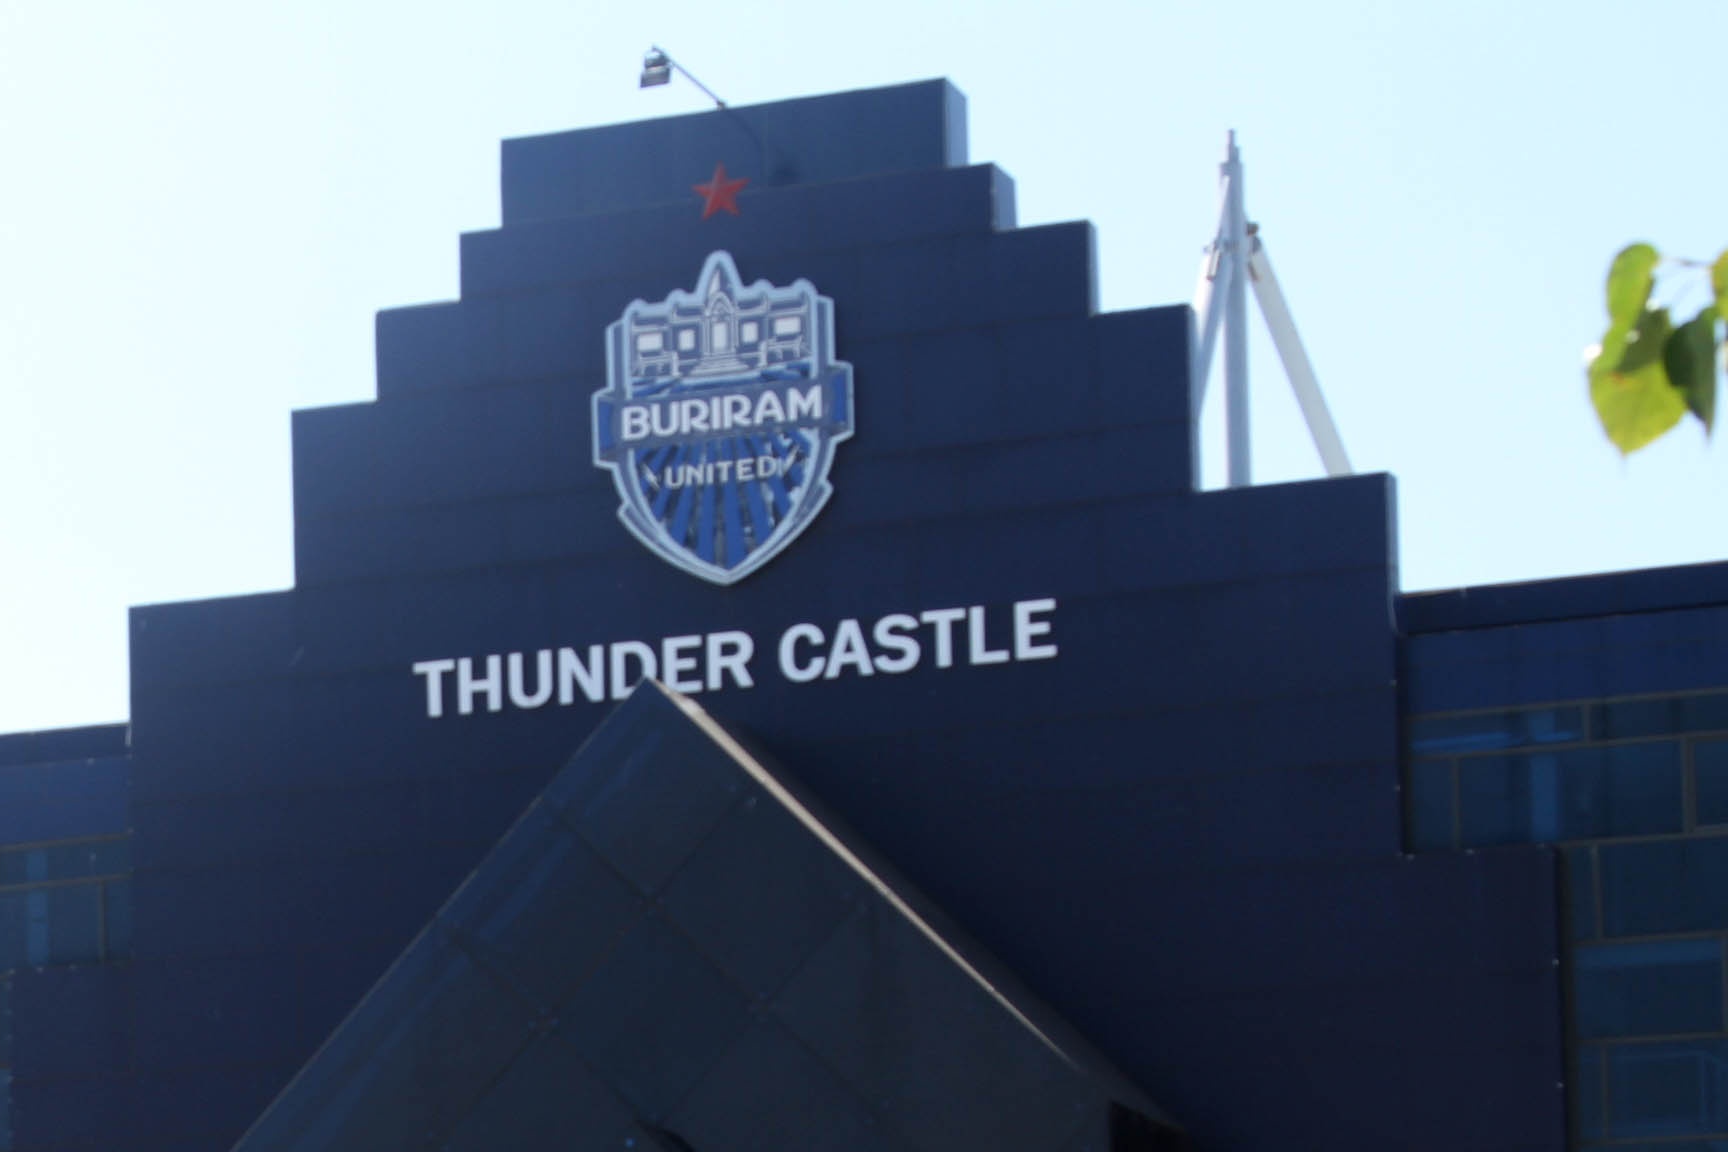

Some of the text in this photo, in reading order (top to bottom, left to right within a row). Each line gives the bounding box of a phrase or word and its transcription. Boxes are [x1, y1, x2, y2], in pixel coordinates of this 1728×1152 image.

[622, 385, 822, 442] BURIRAM
[664, 455, 780, 489] UNITED
[413, 599, 1058, 718] THUNDER CASTLE
